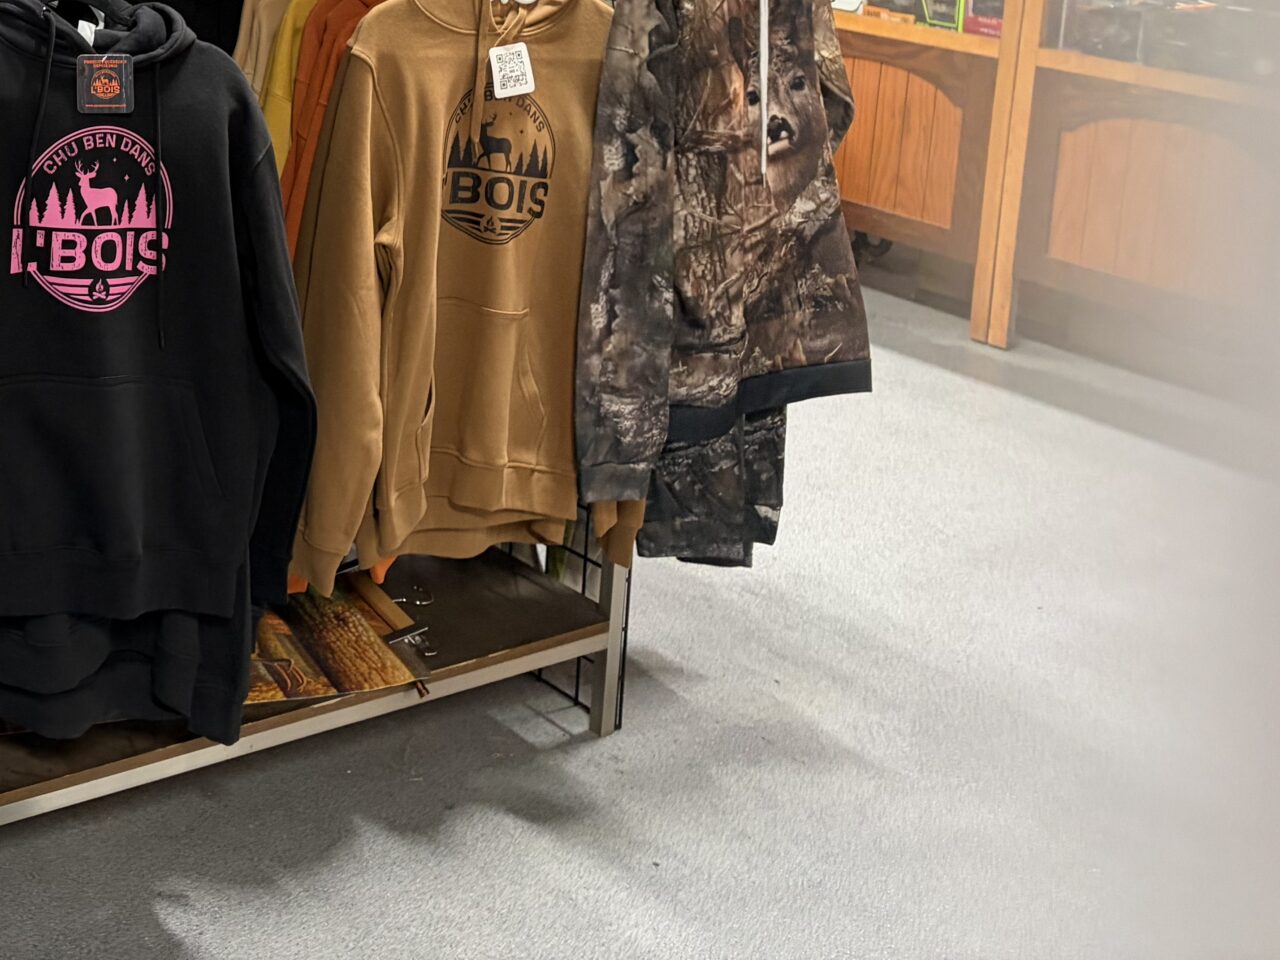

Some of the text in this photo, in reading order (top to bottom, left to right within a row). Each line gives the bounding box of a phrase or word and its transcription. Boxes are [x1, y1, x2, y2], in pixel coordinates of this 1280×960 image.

[43, 133, 157, 177] CHU BEN DANS
[448, 170, 550, 219] BOIS
[9, 227, 170, 275] L'BOIS
